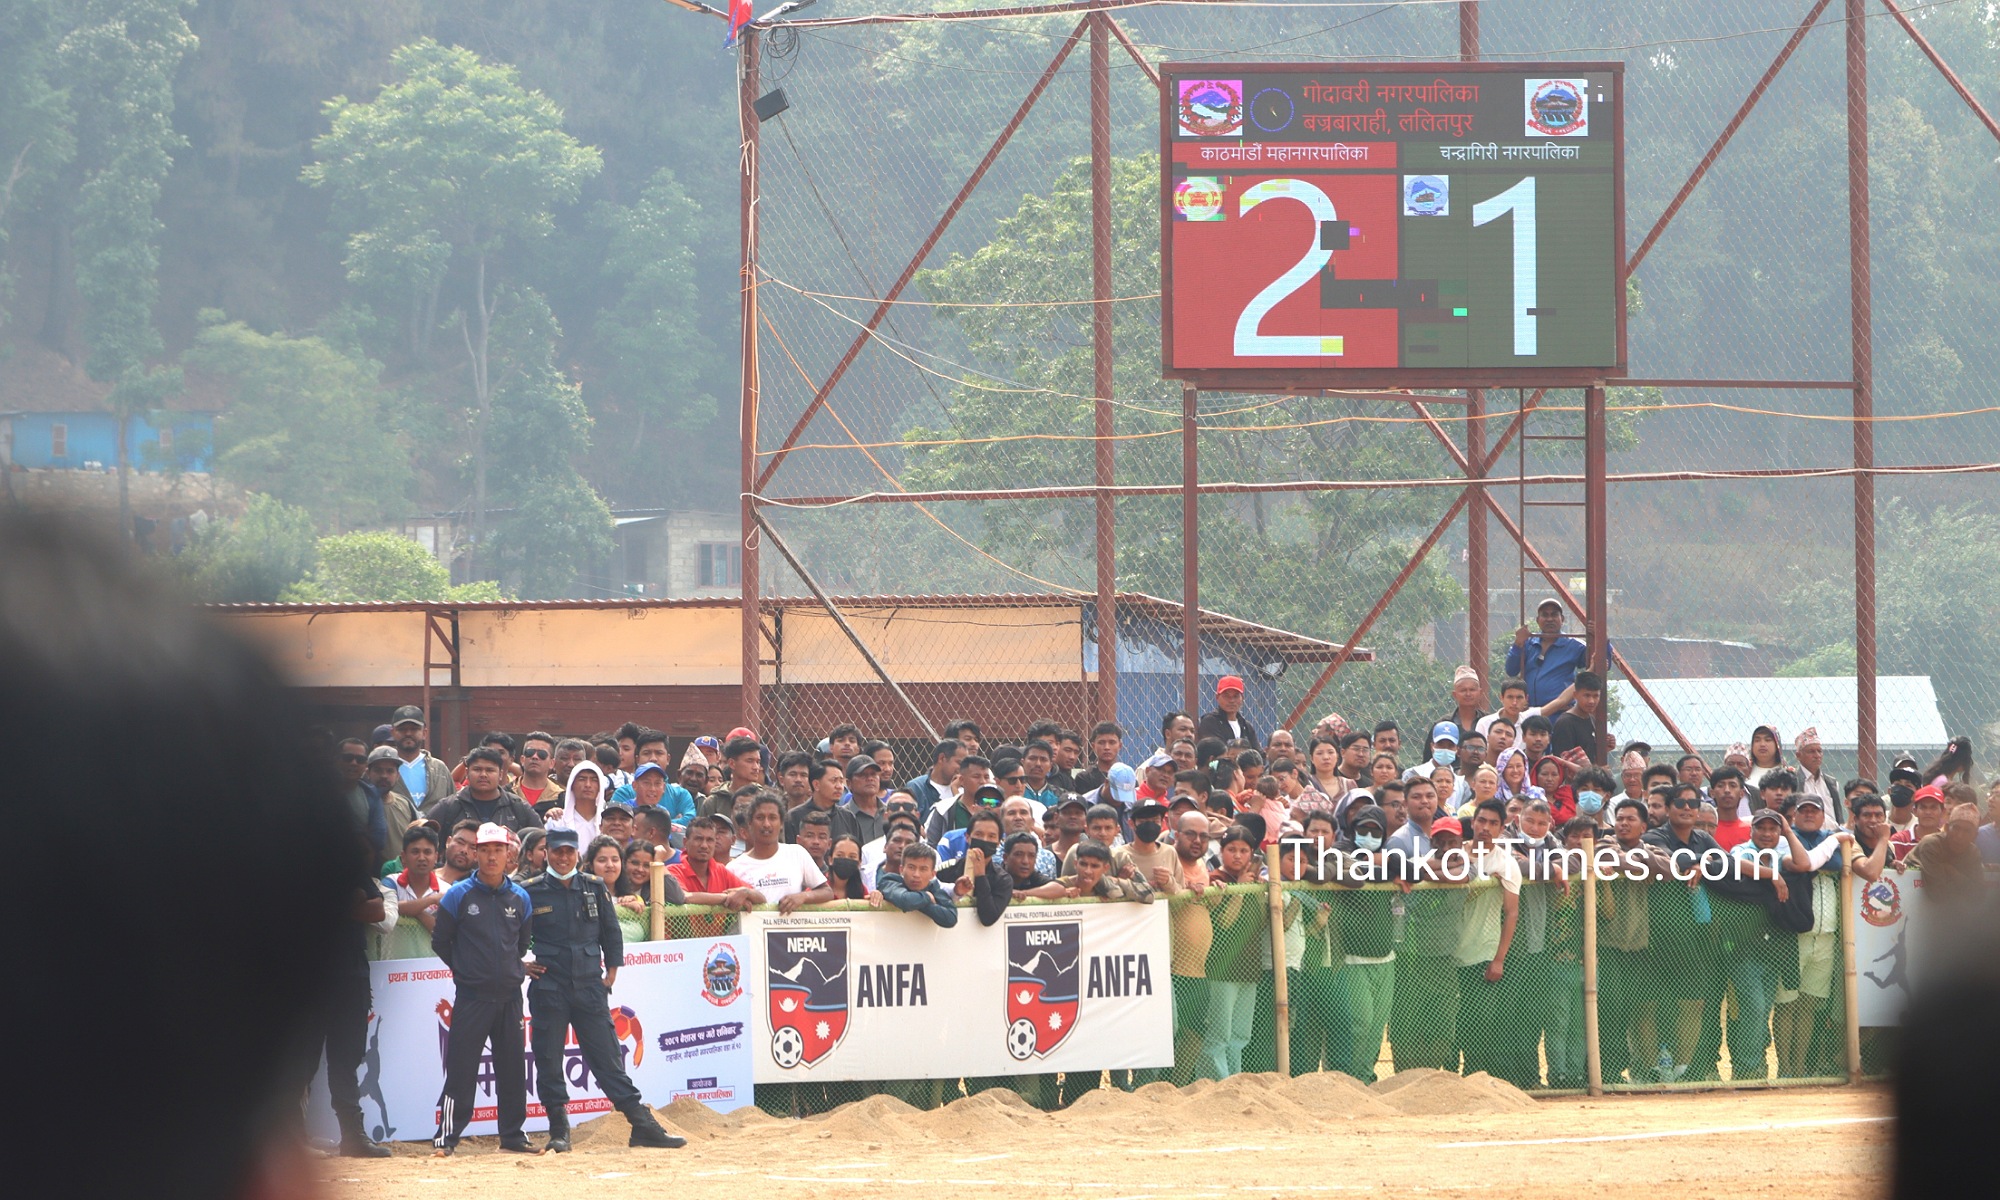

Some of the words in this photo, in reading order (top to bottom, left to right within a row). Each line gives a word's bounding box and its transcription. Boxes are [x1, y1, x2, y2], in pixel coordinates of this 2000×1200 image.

[1302, 79, 1370, 104] गोदावरी
[1376, 78, 1480, 104] नगरपालिका
[1398, 107, 1475, 138] ललितपुर
[1266, 142, 1369, 162] महानगरपालिका
[1439, 142, 1499, 161] चन्द्रागिरी
[1501, 141, 1581, 161] नगरपालिका
[1233, 178, 1344, 357] 2
[1472, 176, 1537, 356] 1
[787, 936, 827, 953] NEPAL
[1026, 930, 1062, 946] NEPAL
[388, 972, 408, 984] प्रथम
[663, 952, 684, 963] २०८१
[1087, 953, 1153, 998] ANFA
[856, 963, 928, 1008] ANFA
